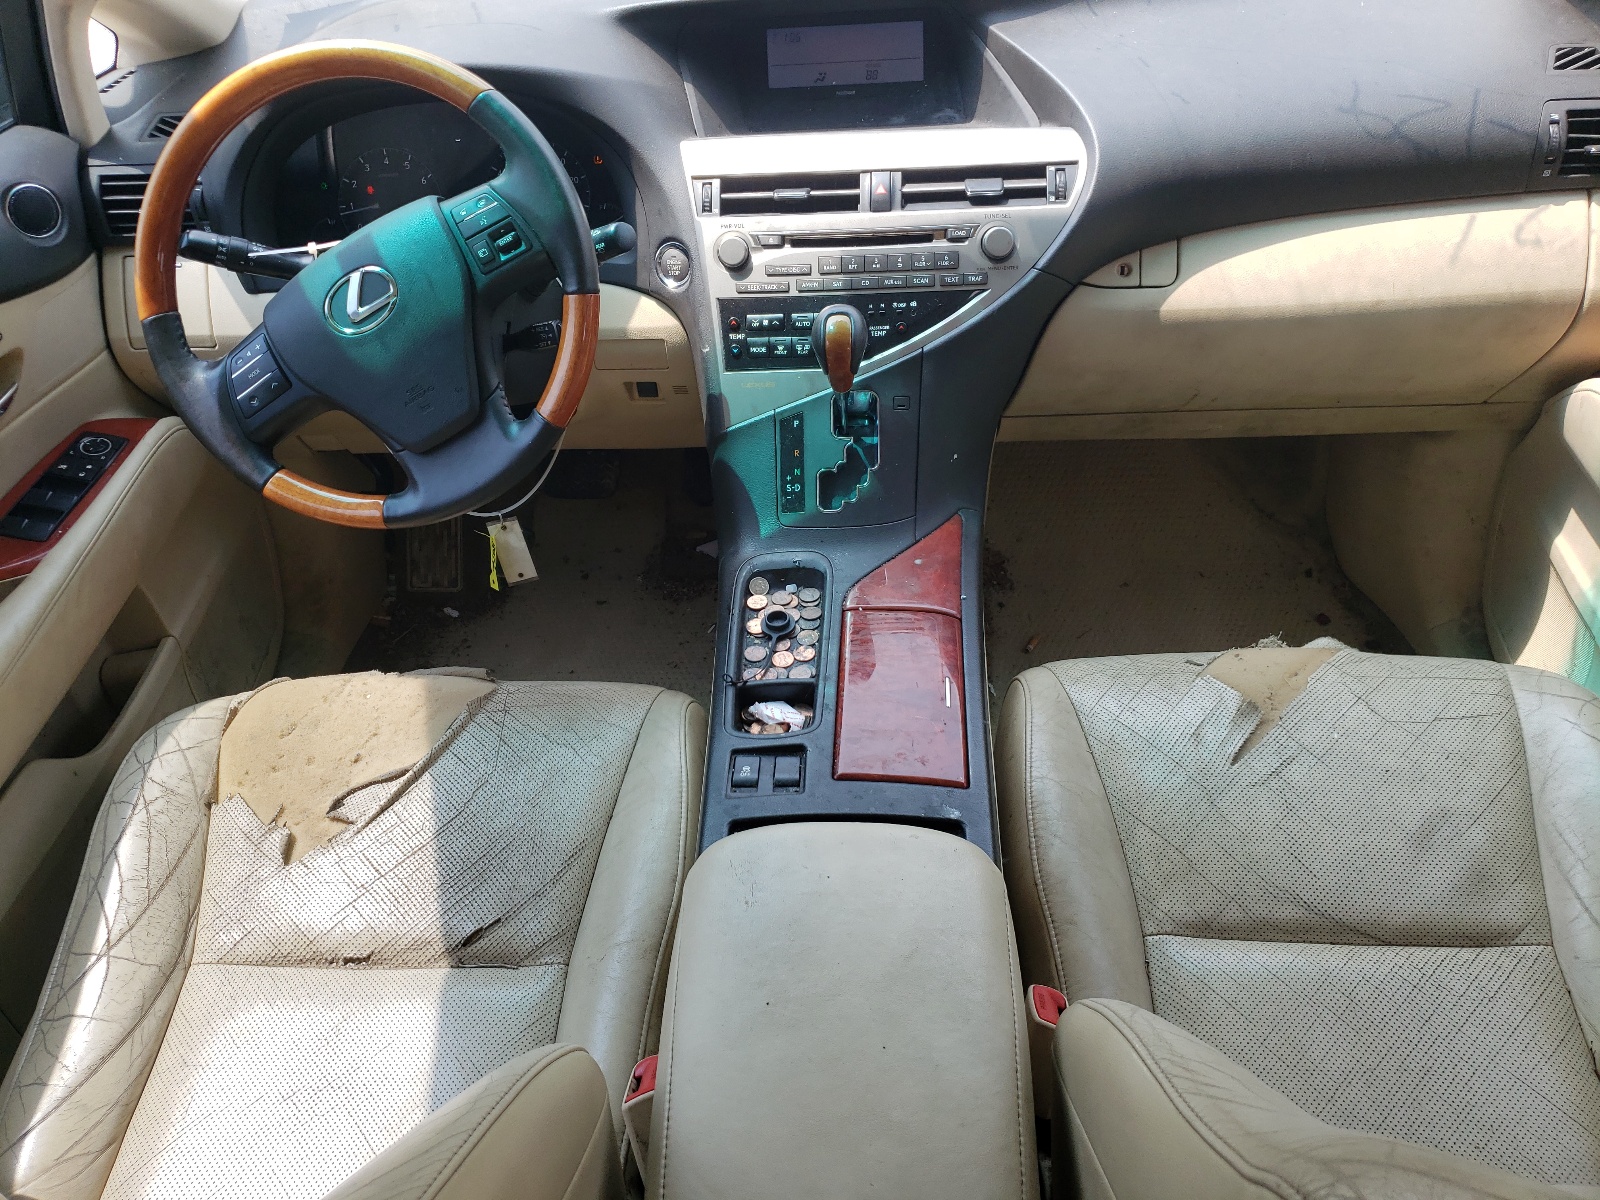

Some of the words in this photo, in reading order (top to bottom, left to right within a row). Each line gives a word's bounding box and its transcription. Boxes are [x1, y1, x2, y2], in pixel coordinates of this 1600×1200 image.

[383, 156, 389, 165] 4
[364, 163, 370, 172] 3
[403, 161, 411, 170] 5
[247, 367, 261, 380] MODE
[794, 449, 800, 457] R
[794, 468, 801, 476] N
